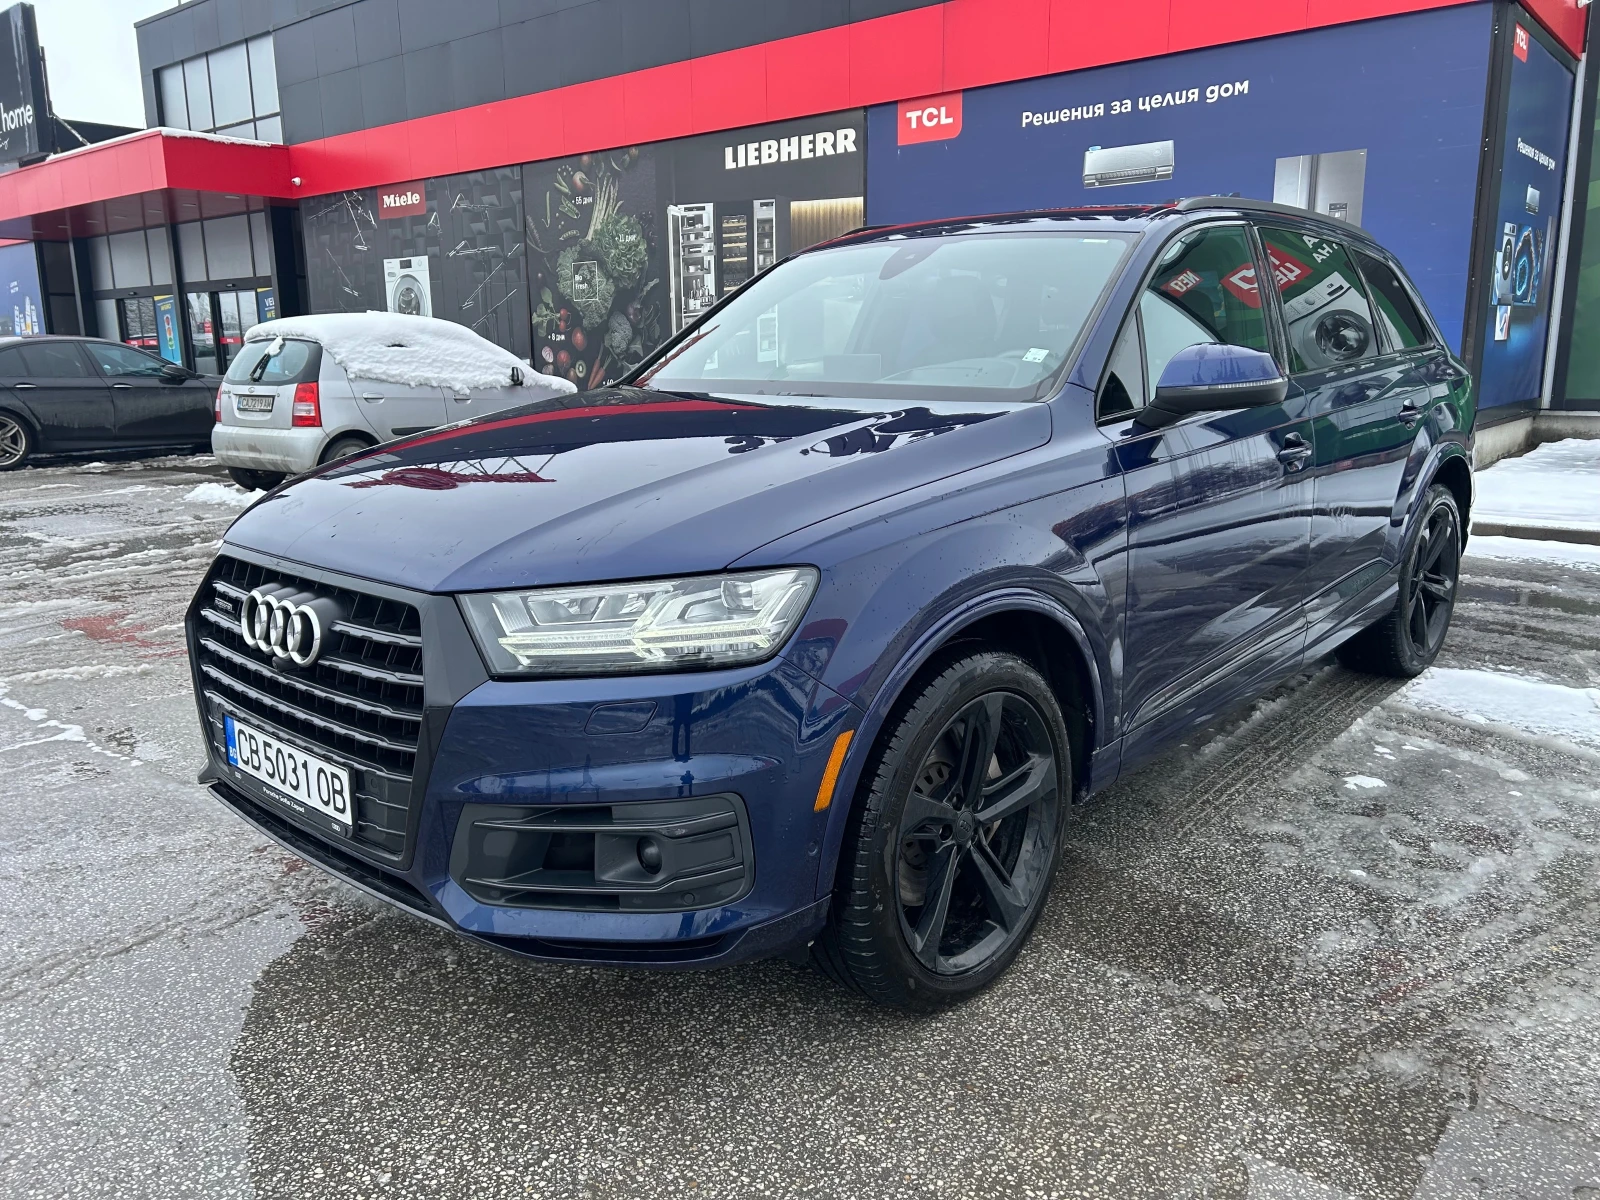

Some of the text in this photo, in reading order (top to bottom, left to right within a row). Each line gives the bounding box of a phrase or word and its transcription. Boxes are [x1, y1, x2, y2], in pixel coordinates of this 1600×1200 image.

[1516, 27, 1527, 50] TCL
[1022, 80, 1250, 128] Решения за целия дом
[906, 106, 954, 129] TCL
[724, 128, 857, 170] LIEBHERR
[382, 192, 420, 208] Miele
